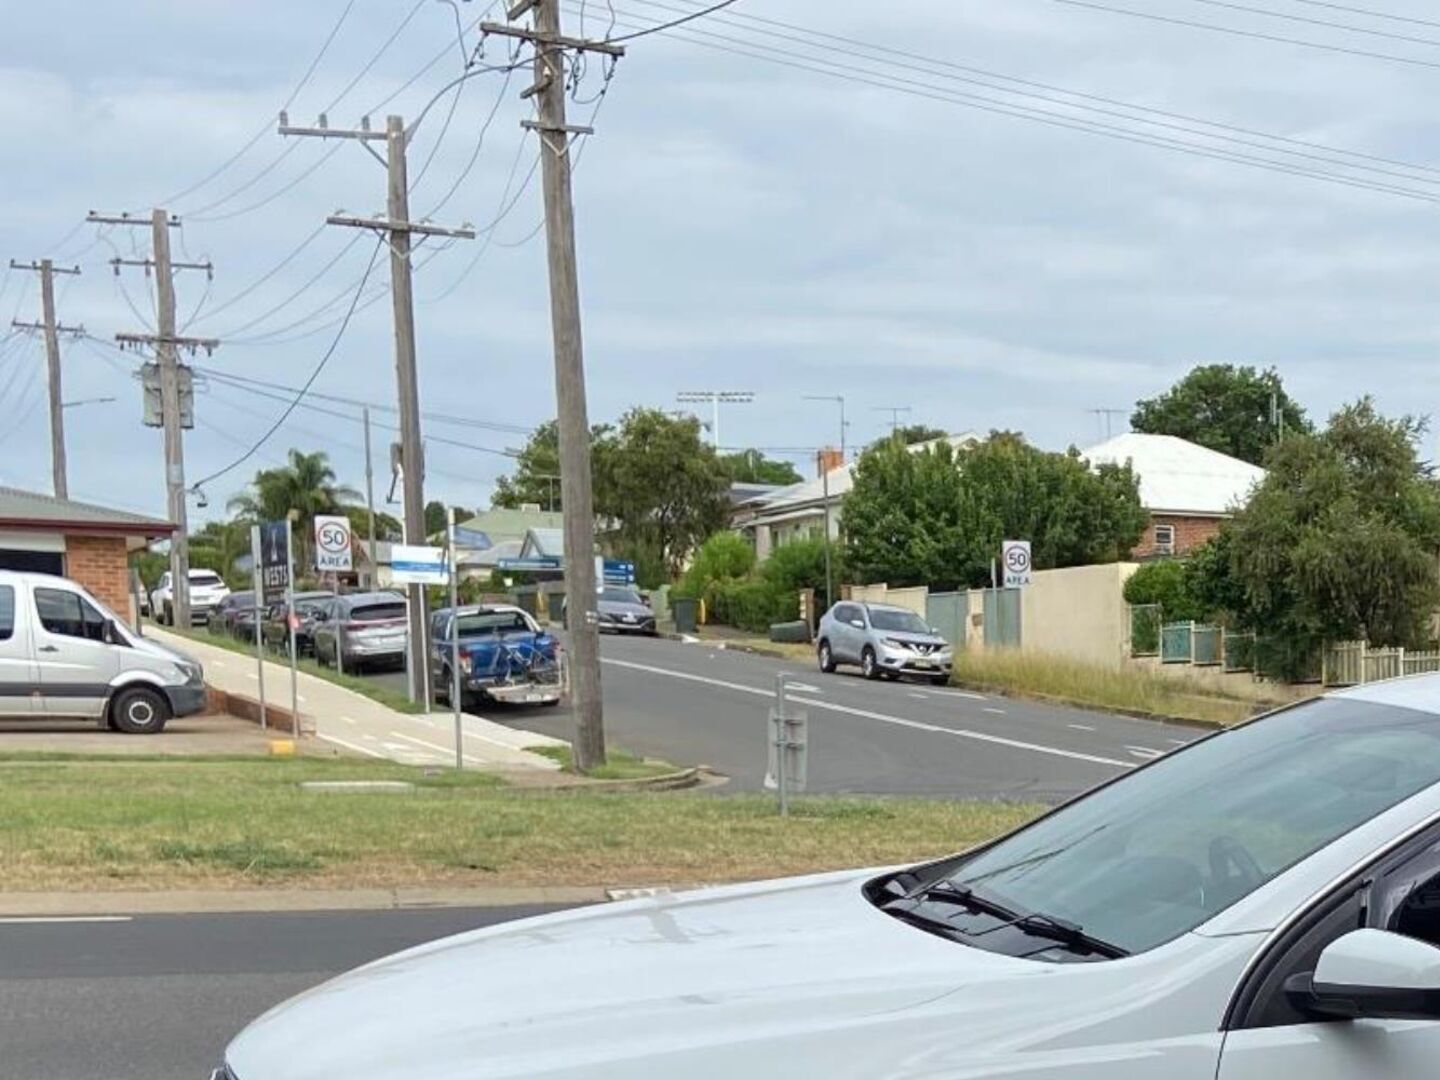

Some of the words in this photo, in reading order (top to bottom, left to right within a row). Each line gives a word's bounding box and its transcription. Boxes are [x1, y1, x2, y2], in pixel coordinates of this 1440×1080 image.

[323, 530, 345, 546] 50
[320, 556, 349, 567] AREA
[1009, 552, 1026, 567] 50
[1006, 576, 1030, 585] AREA
